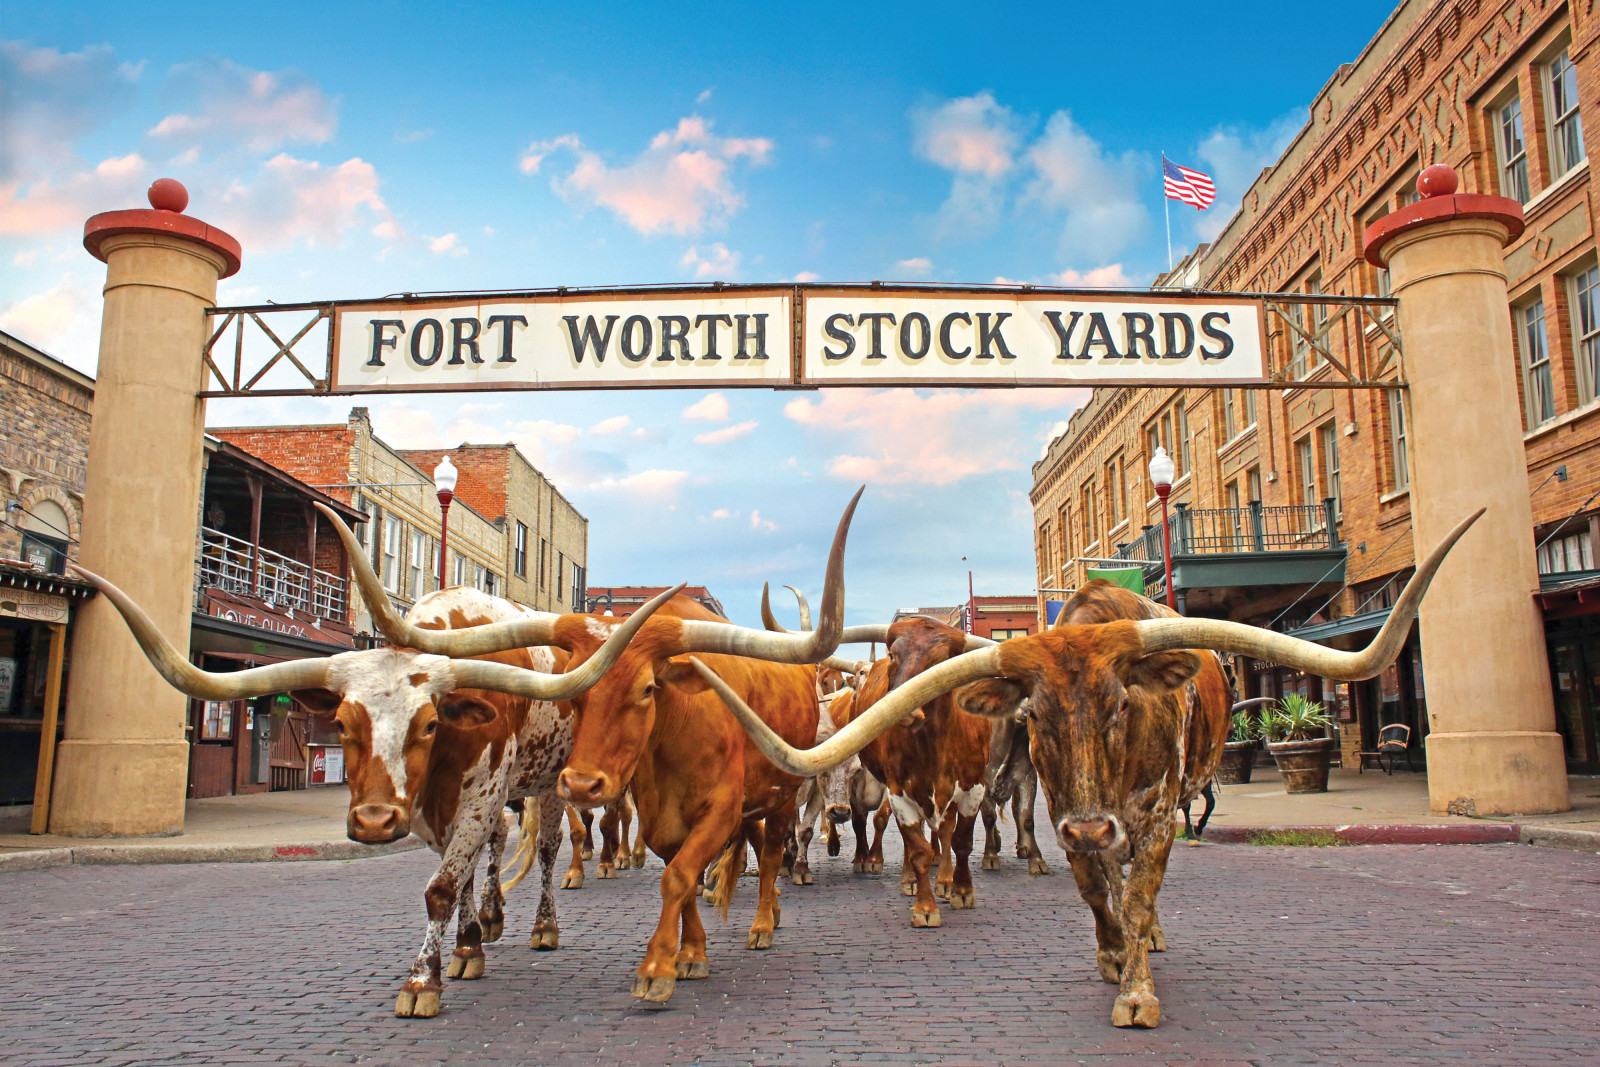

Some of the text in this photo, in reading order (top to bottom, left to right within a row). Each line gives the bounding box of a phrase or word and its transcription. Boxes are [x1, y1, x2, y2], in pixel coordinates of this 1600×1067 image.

[367, 311, 1235, 367] FORT WORTH STOCK YARDS
[1, 589, 65, 608] HOUSE OF BLADES
[1144, 581, 1164, 599] OTEL
[22, 604, 59, 618] KNIFE ALLEY
